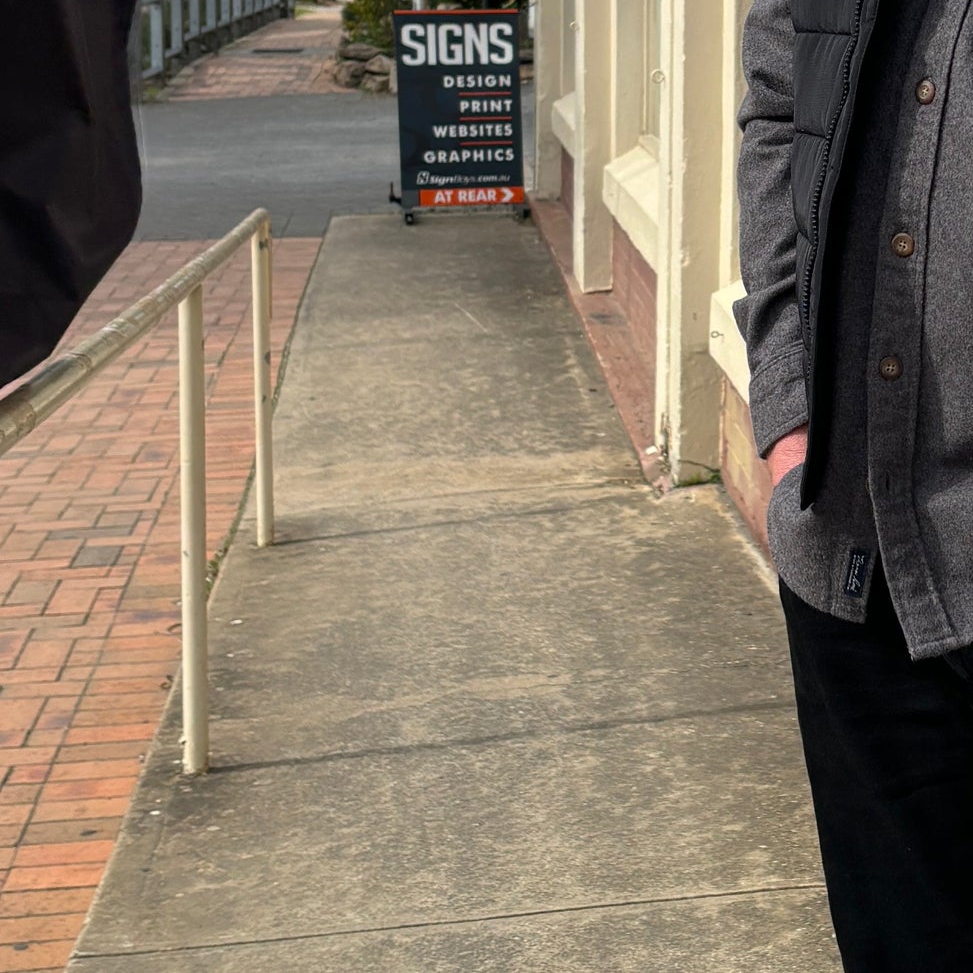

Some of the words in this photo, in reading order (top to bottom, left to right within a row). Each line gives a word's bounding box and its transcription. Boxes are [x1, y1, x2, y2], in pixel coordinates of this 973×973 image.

[401, 23, 513, 66] SIGNS
[443, 75, 511, 88] DESIGN
[460, 100, 513, 113] PRINT
[433, 124, 513, 138] WEBSITES
[424, 148, 514, 164] GRAPHICS
[434, 190, 453, 204] AT
[458, 189, 497, 203] REAR
